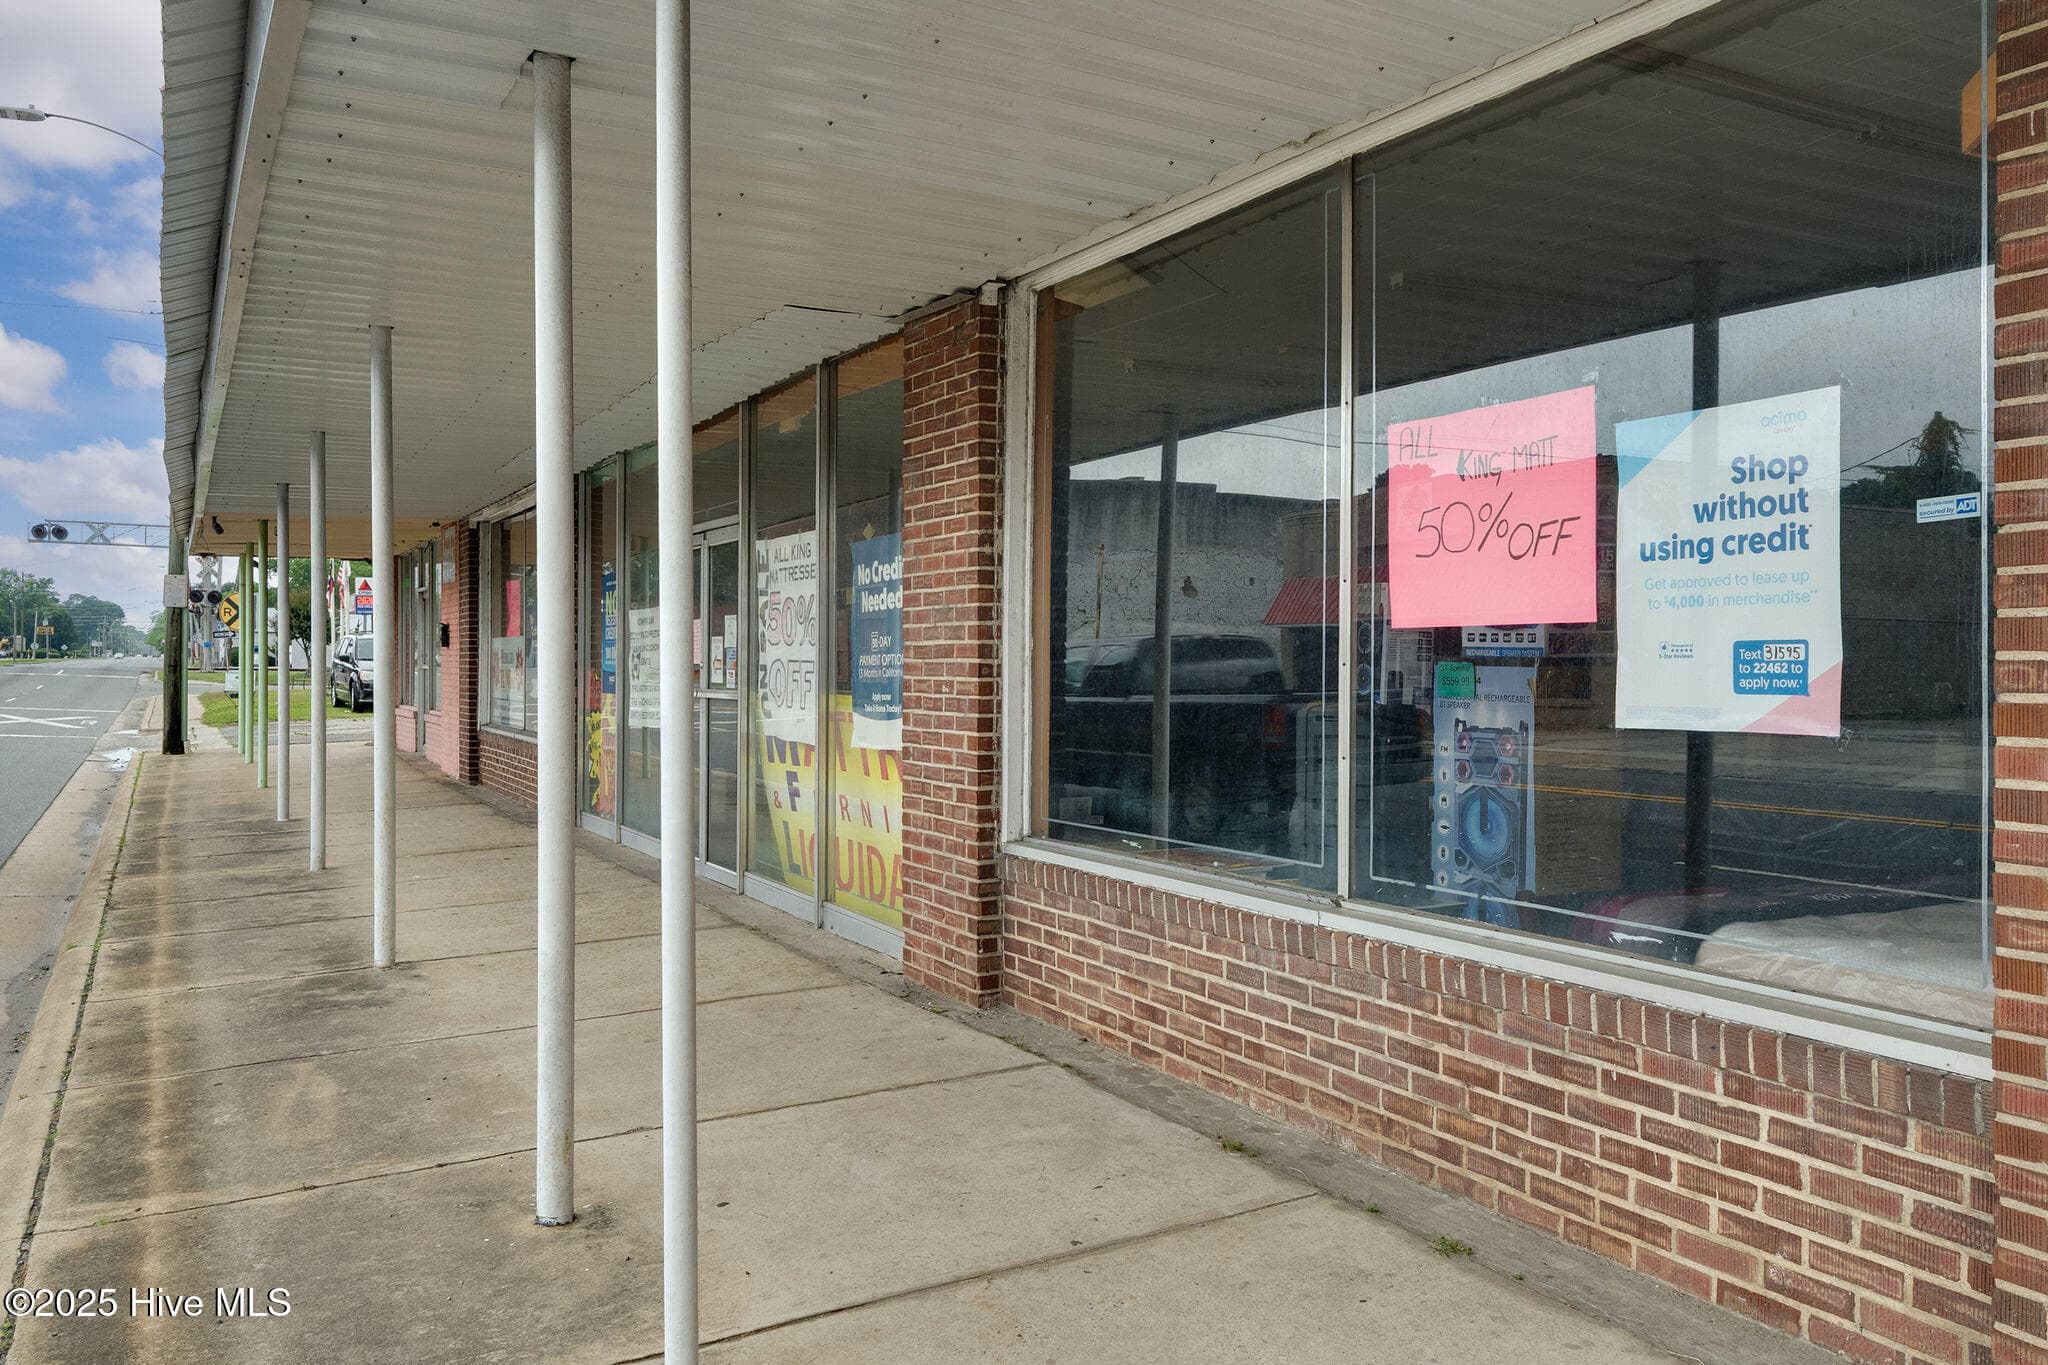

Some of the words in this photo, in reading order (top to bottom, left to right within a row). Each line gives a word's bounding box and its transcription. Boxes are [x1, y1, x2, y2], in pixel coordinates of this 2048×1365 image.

[1400, 425, 1438, 462] ALL
[1456, 449, 1502, 487] KING
[1513, 435, 1559, 473] MATT
[1731, 454, 1809, 485] Shop
[1693, 487, 1809, 523] without
[1920, 507, 1946, 516] secured
[1957, 500, 1977, 511] ADT
[1416, 491, 1513, 557] 50%
[1508, 516, 1581, 560] OFF
[774, 547, 789, 562] ALL
[791, 542, 811, 560] KING
[1640, 533, 1714, 564] using
[1721, 522, 1810, 556] credit
[857, 563, 871, 586] No
[872, 556, 903, 583] Credi
[1644, 578, 1666, 590] Get
[1670, 573, 1731, 591] approved
[1735, 573, 1748, 585] to
[1753, 571, 1787, 584] lease
[1791, 571, 1810, 584] up
[861, 585, 903, 613] Needed
[1648, 599, 1661, 609] to
[1708, 594, 1719, 607] in
[224, 608, 232, 617] R
[767, 591, 816, 646] 50%
[1739, 649, 1762, 660] Text
[1739, 663, 1751, 674] to
[1753, 662, 1789, 674] 22462
[1791, 663, 1803, 674] to
[769, 658, 815, 710] OFF
[1442, 676, 1470, 687] $559.99
[1739, 677, 1770, 690] apply
[1447, 701, 1471, 710] SPEAKER
[1484, 694, 1531, 704] RECHARGEABLE
[774, 791, 782, 809] &
